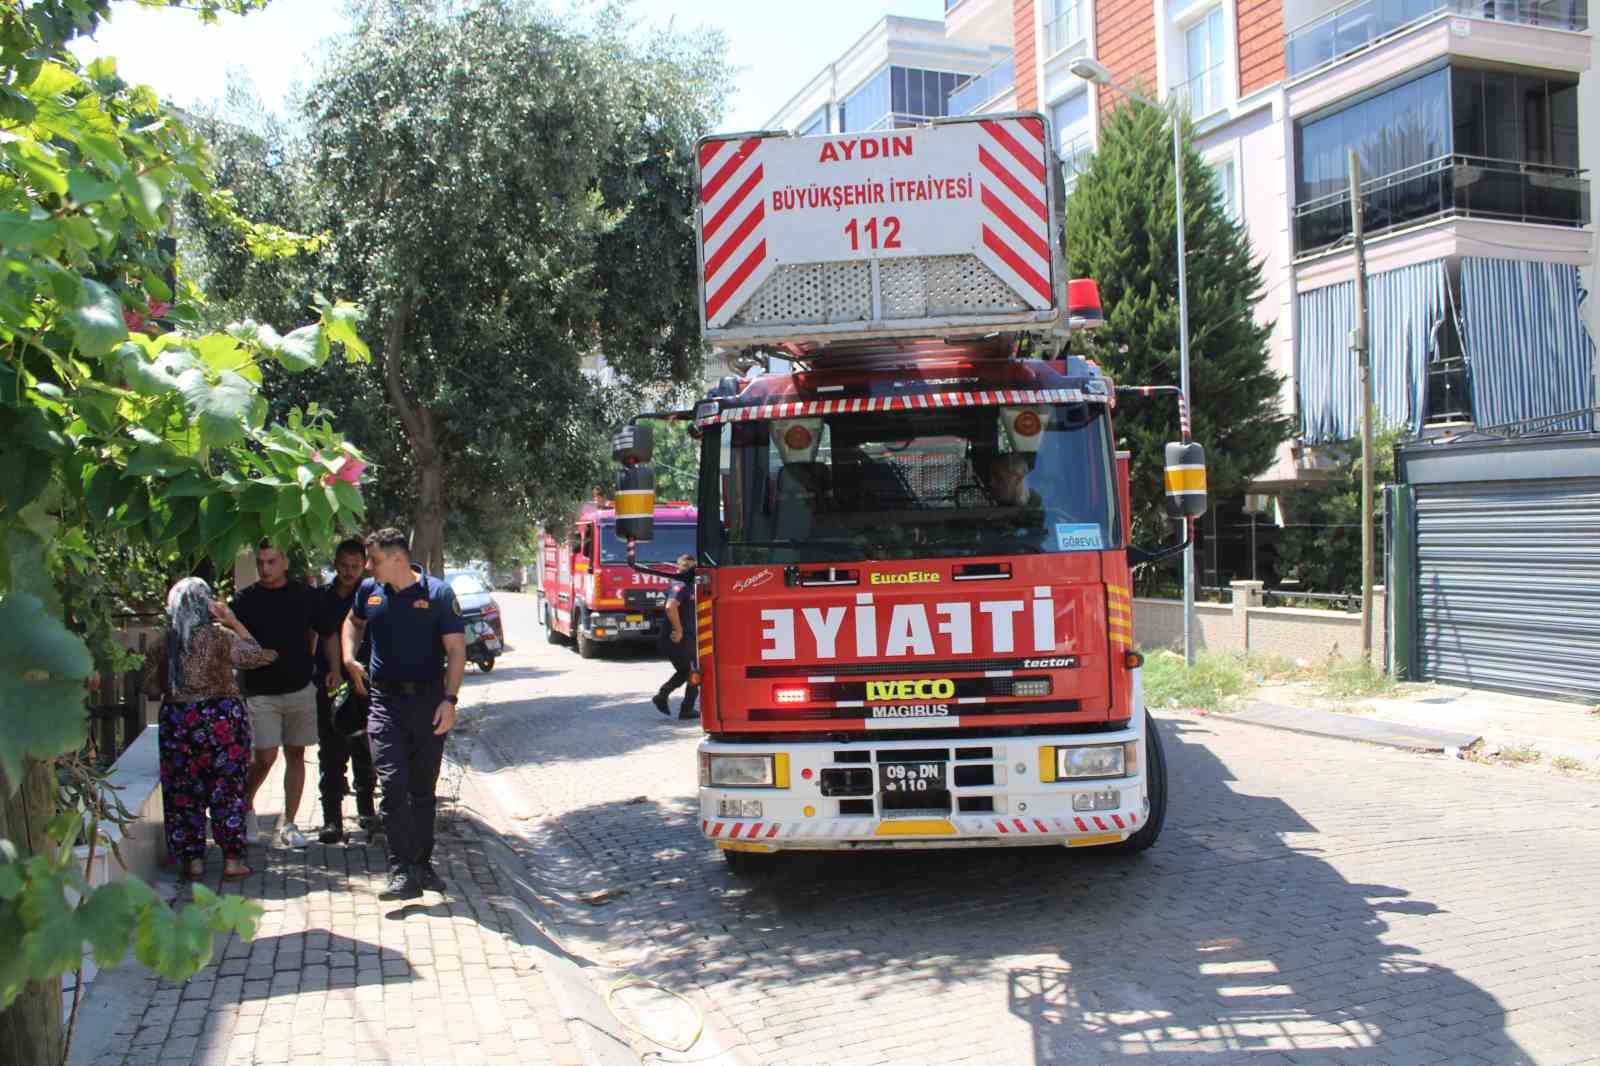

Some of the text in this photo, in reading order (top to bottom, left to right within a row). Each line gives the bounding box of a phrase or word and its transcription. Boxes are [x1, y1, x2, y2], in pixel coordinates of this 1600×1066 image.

[818, 135, 913, 163] AYDIN
[772, 172, 973, 212] BÜYÜKŞEHİR İTFAİYESİ
[844, 216, 902, 250] 112
[870, 571, 940, 585] EuroFire
[1023, 657, 1075, 668] tector
[866, 678, 955, 701] IVECO
[872, 703, 949, 718] MAGIRUS
[887, 764, 939, 779] 09 DN
